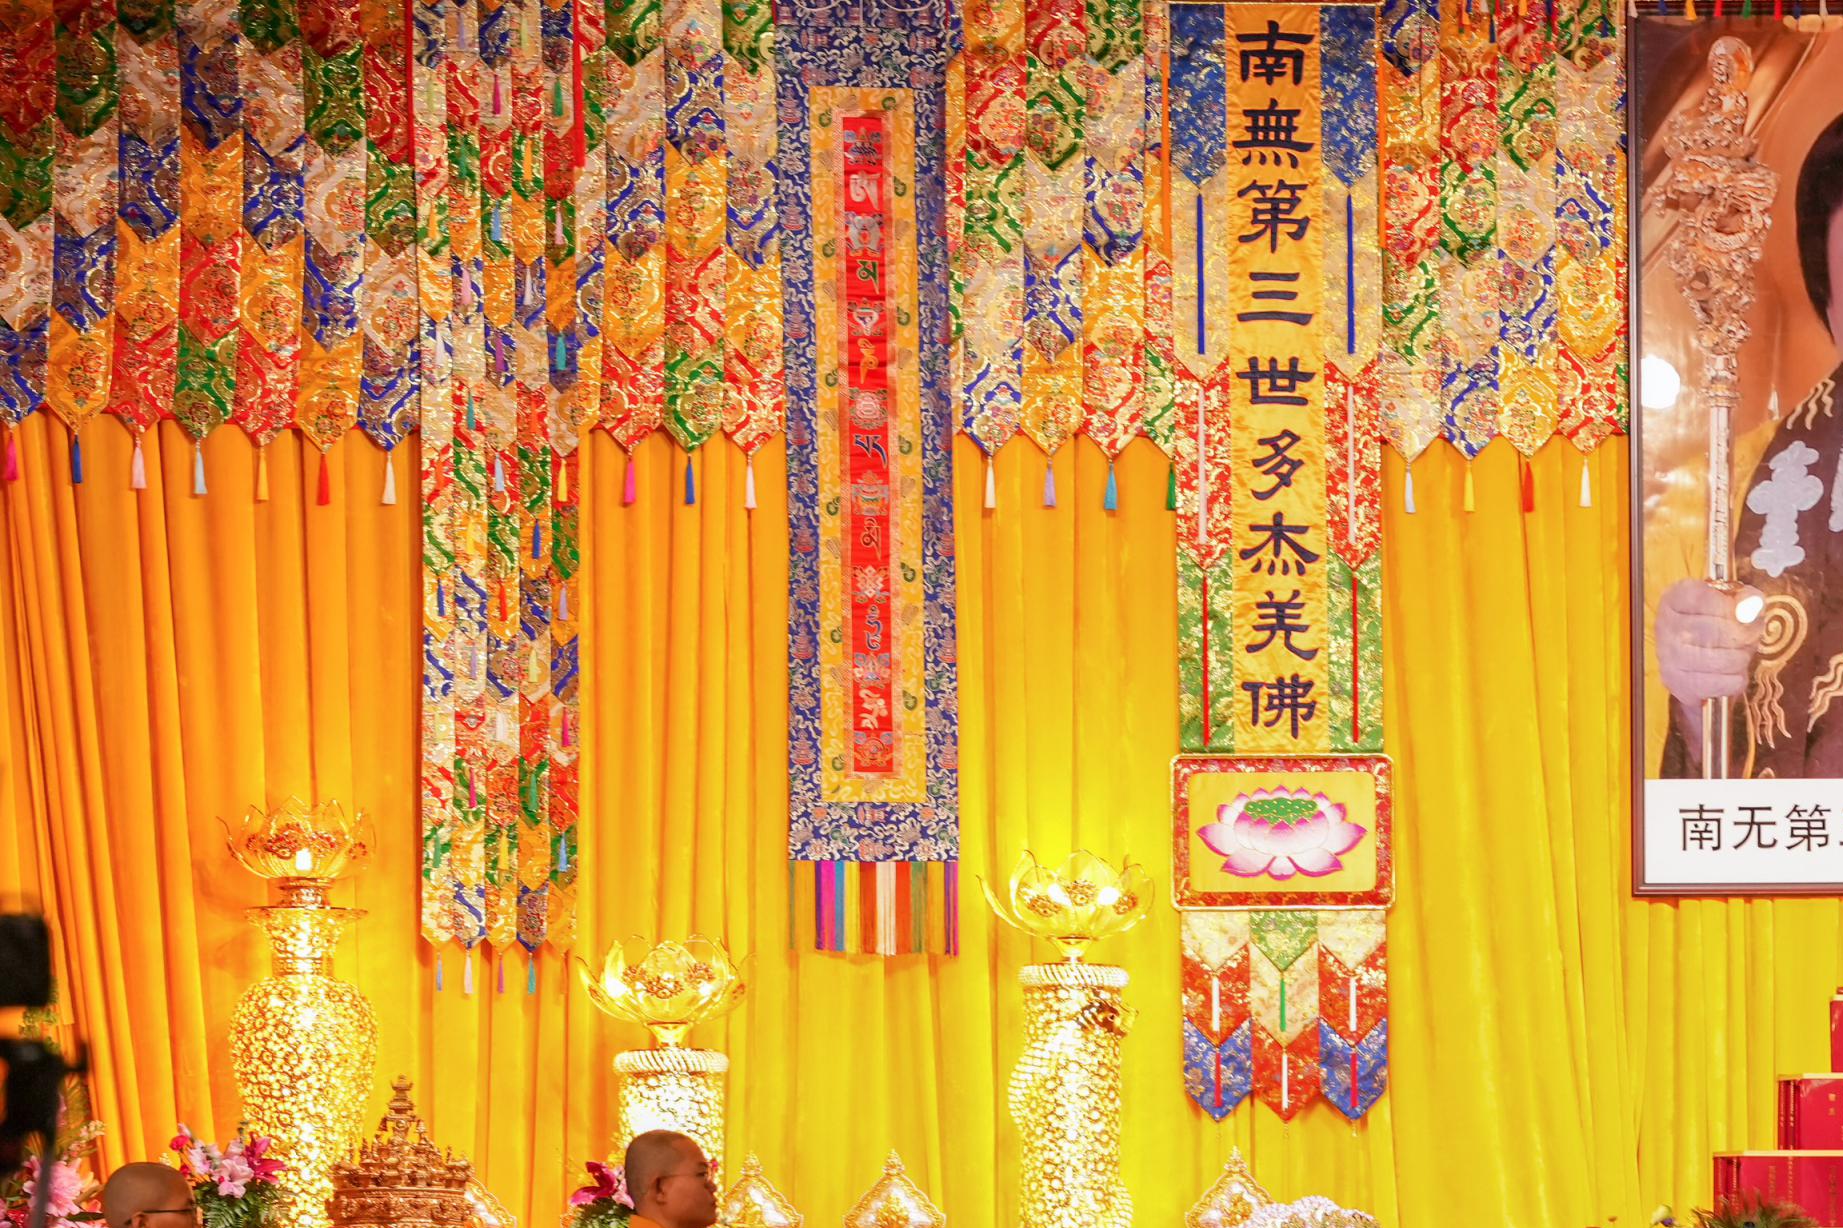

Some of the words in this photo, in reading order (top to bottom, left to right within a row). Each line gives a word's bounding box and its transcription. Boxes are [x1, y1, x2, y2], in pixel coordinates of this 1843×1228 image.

[1235, 20, 1321, 739] 南無第三世多杰羌佛
